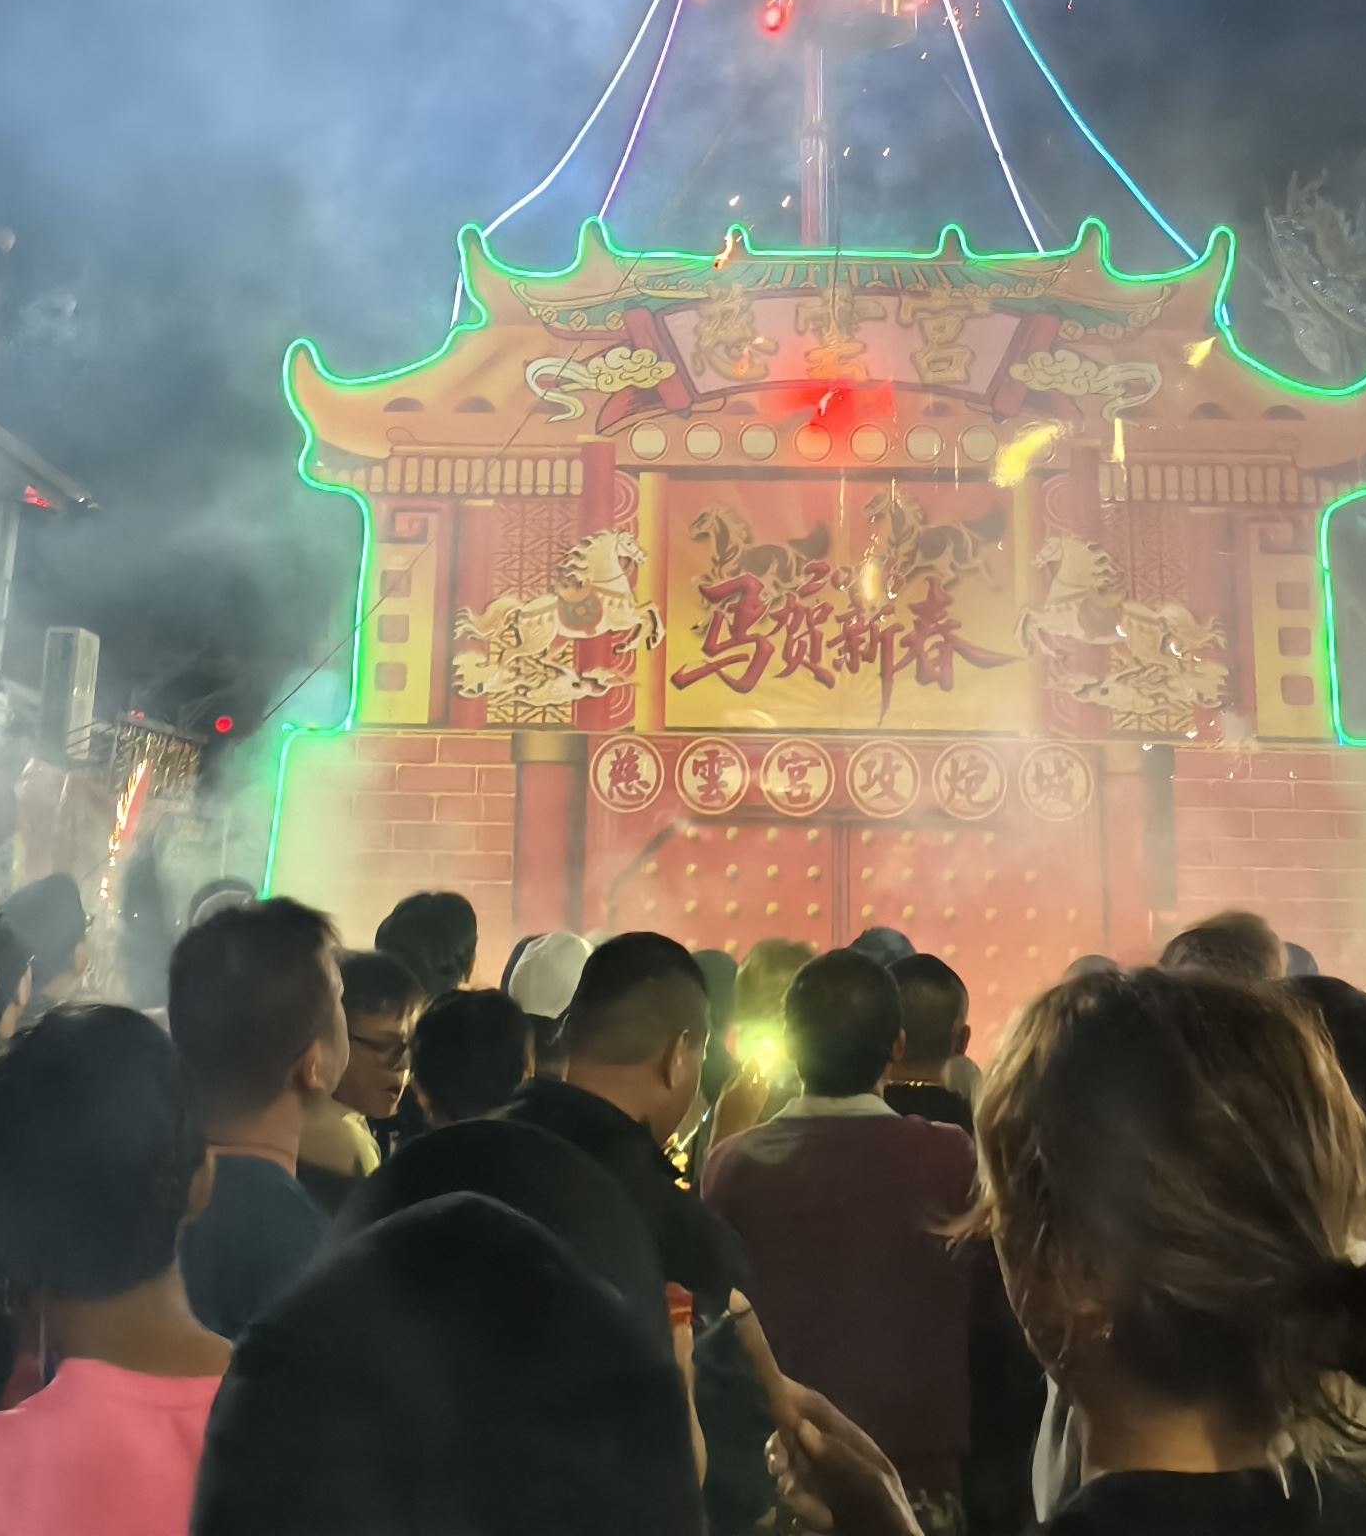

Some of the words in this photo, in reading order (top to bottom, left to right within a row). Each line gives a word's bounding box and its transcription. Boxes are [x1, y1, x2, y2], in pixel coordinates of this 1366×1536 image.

[797, 556, 907, 608] 206
[670, 571, 1025, 727] 马贺新春
